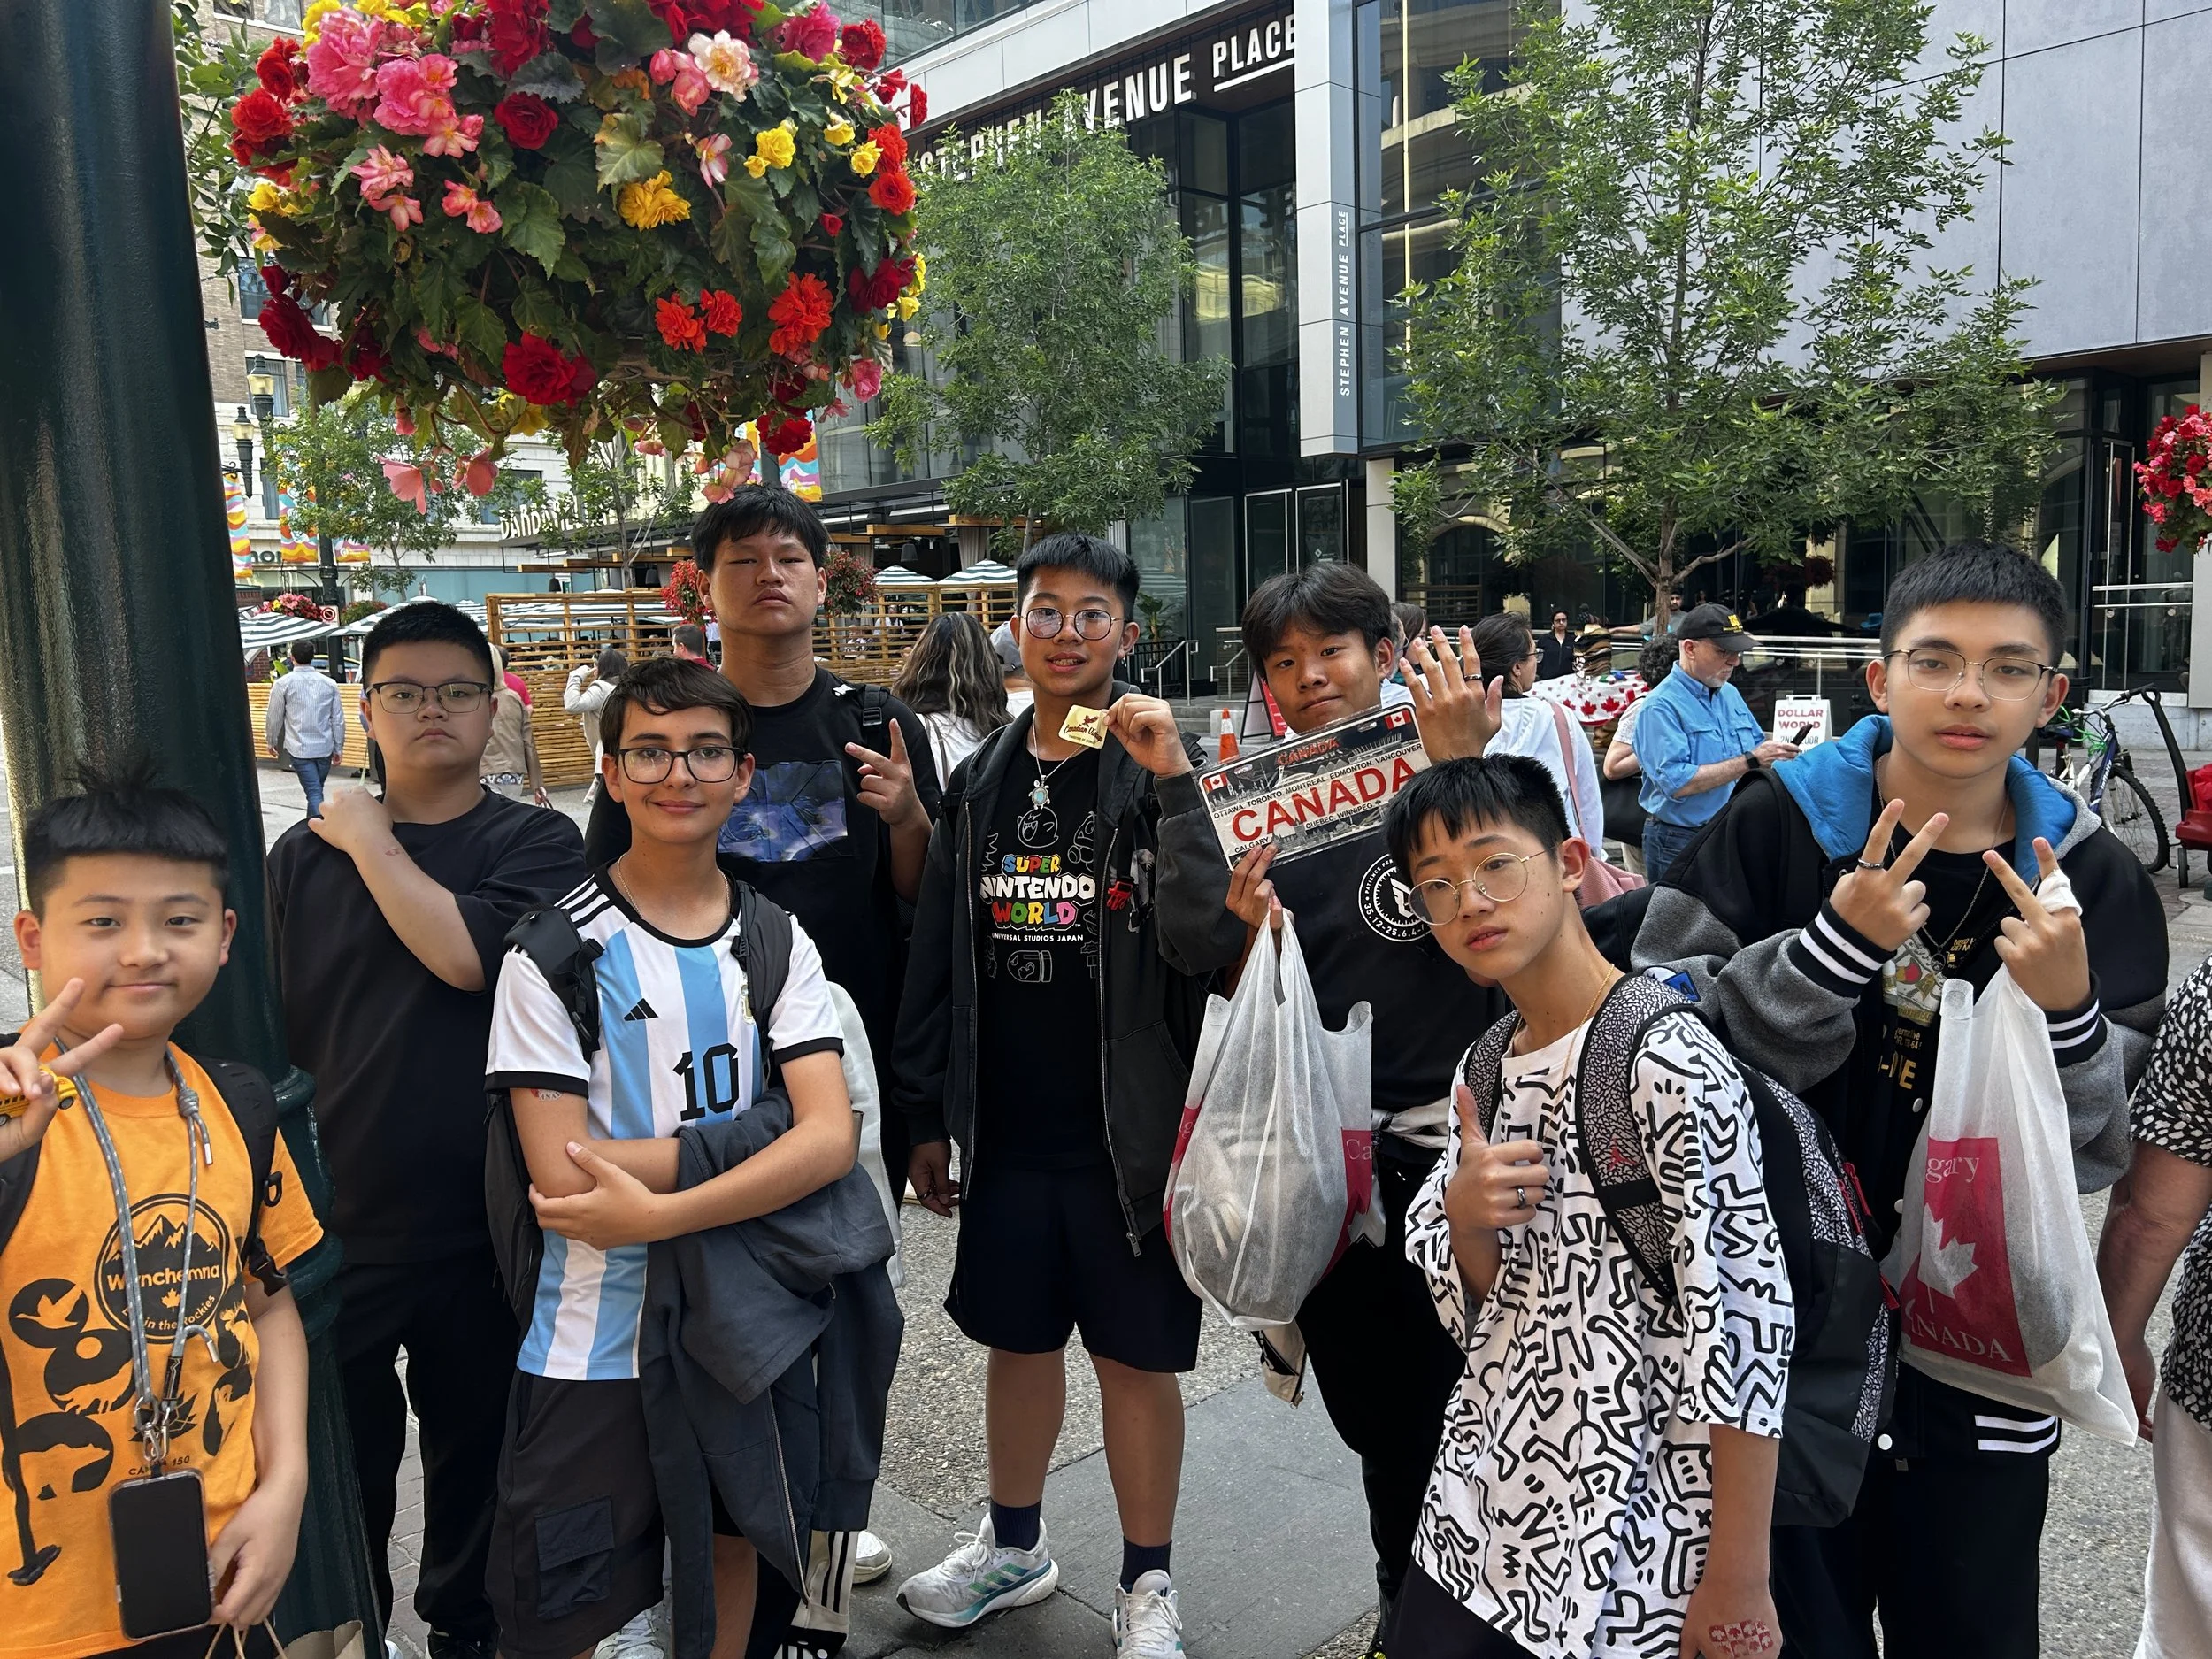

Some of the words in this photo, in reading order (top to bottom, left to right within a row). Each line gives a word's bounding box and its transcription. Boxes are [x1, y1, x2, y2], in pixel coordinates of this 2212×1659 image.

[1213, 14, 1295, 79] PLACE
[1338, 210, 1347, 247] PLACE
[1338, 254, 1349, 316] AVENUE
[1340, 326, 1350, 396] STEPHEN
[1778, 709, 1824, 718] DOLLAR
[1778, 720, 1821, 730] WORD
[1277, 737, 1340, 766] CANADA
[1375, 743, 1423, 764] VANCOUVER
[1232, 757, 1417, 841] CANADA
[1002, 854, 1061, 874] SUPER
[979, 873, 1096, 900] NINTENDO
[1364, 866, 1382, 895] PATIENCE
[991, 901, 1077, 926] WORLD
[991, 932, 1021, 942] UNIVERSAL
[1024, 933, 1055, 942] STUDIOS
[1056, 933, 1084, 942] JAPAN
[673, 1042, 739, 1122] 10
[107, 1264, 220, 1292] Wnchemna
[143, 1317, 156, 1328] in
[158, 1319, 178, 1331] the
[1905, 1298, 2015, 1363] CNADA
[172, 1455, 190, 1468] 150
